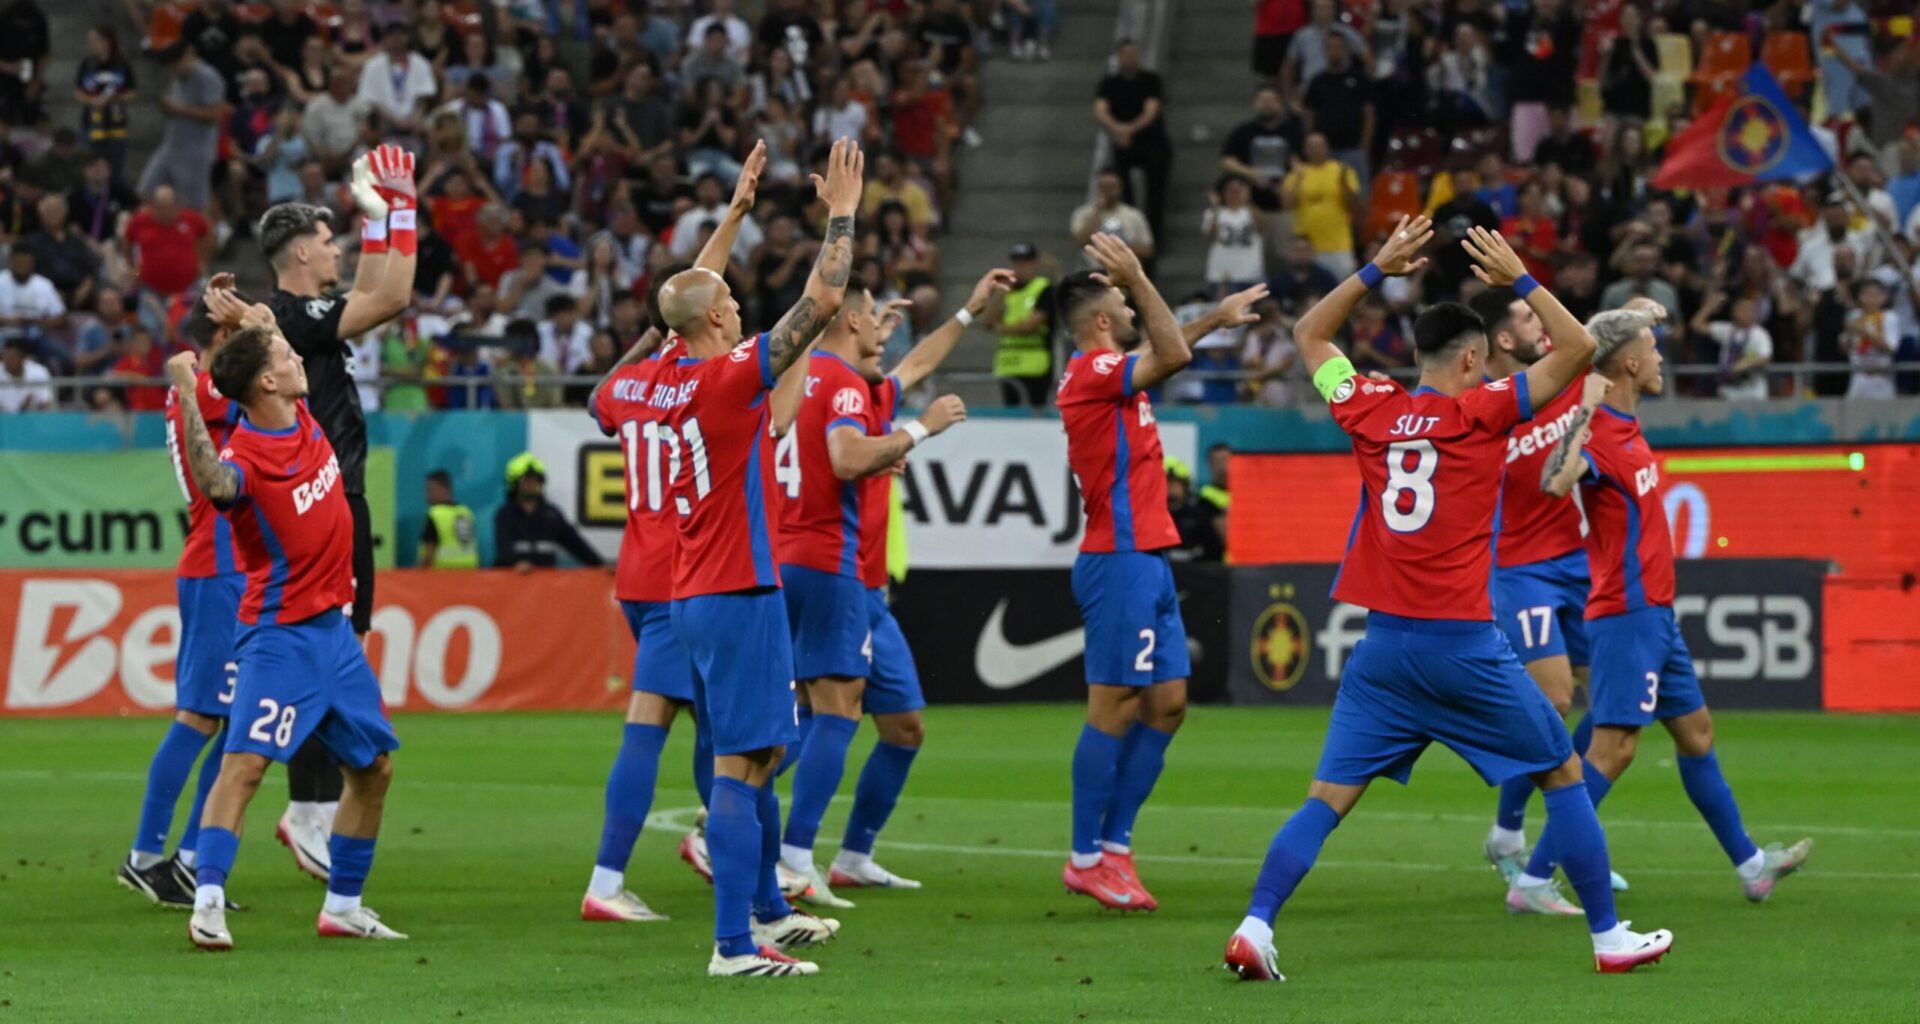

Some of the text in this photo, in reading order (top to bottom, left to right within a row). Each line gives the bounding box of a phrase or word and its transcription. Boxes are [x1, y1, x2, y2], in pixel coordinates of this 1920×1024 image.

[1389, 414, 1440, 436] SUT
[1381, 438, 1440, 532] 8
[18, 510, 163, 554] cum
[1516, 606, 1552, 649] 17
[1133, 628, 1156, 672] 2
[1639, 671, 1659, 713] 3
[248, 698, 297, 749] 28
